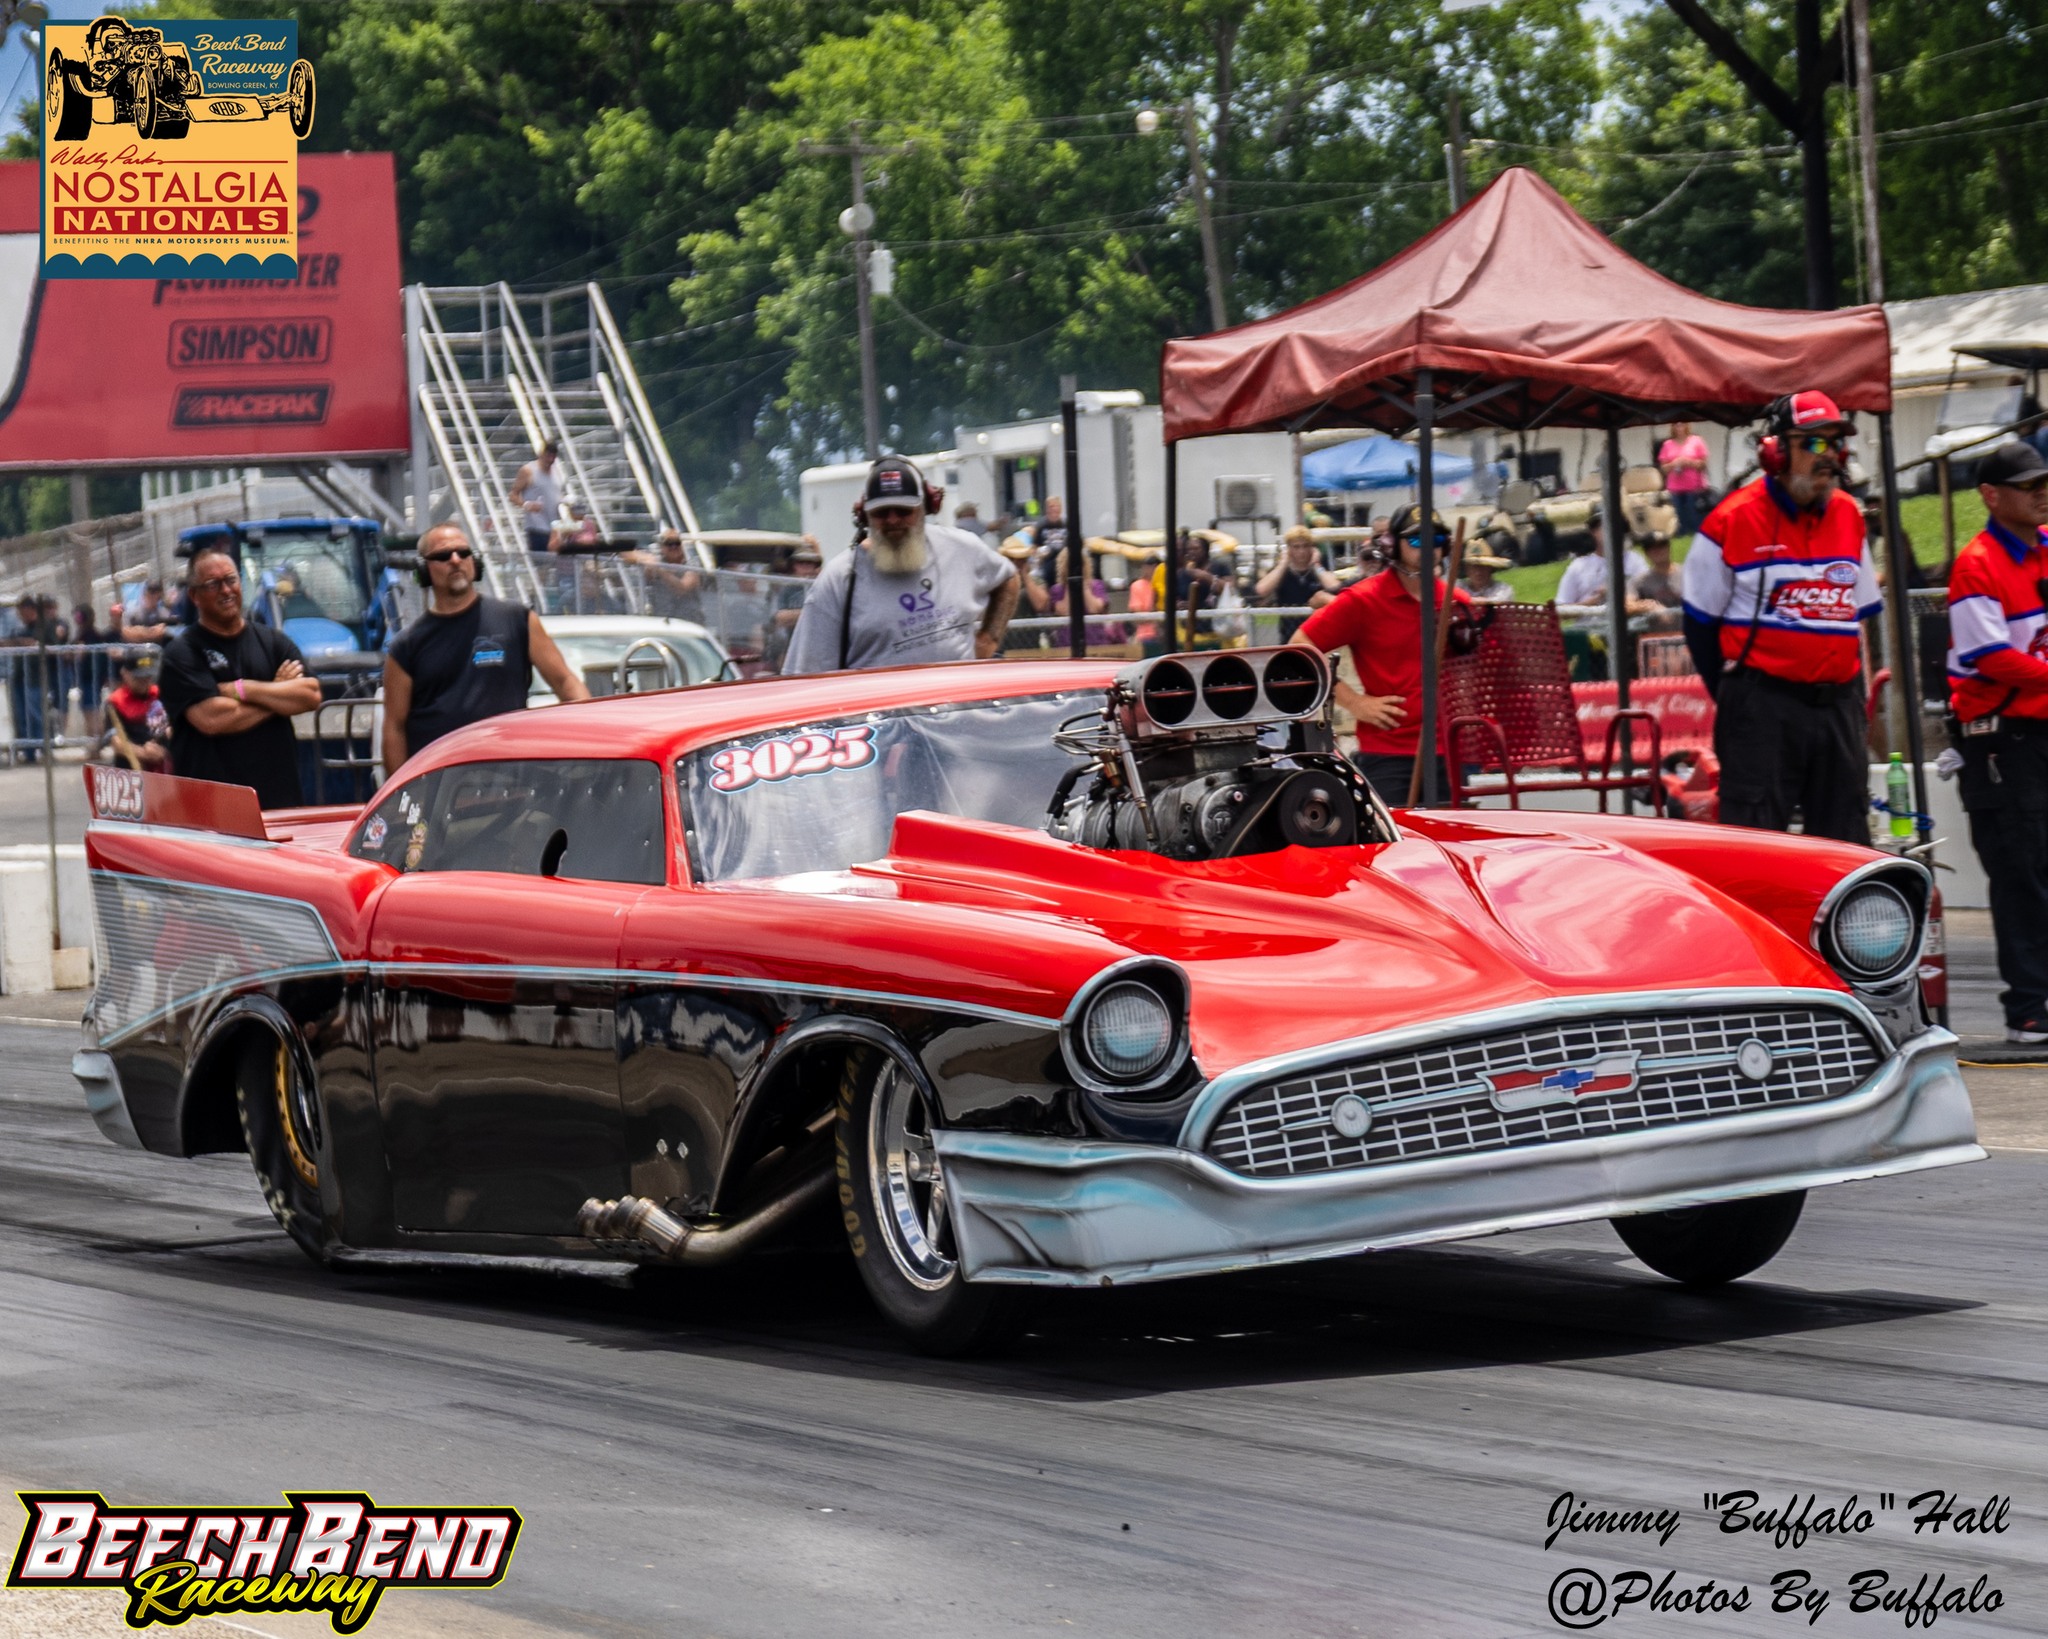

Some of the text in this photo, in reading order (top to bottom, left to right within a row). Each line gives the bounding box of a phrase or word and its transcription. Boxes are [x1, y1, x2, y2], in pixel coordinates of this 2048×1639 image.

[178, 322, 321, 363] SIMPSON
[1775, 586, 1842, 606] LUCAS
[711, 726, 876, 791] 3025
[95, 768, 143, 819] 3025
